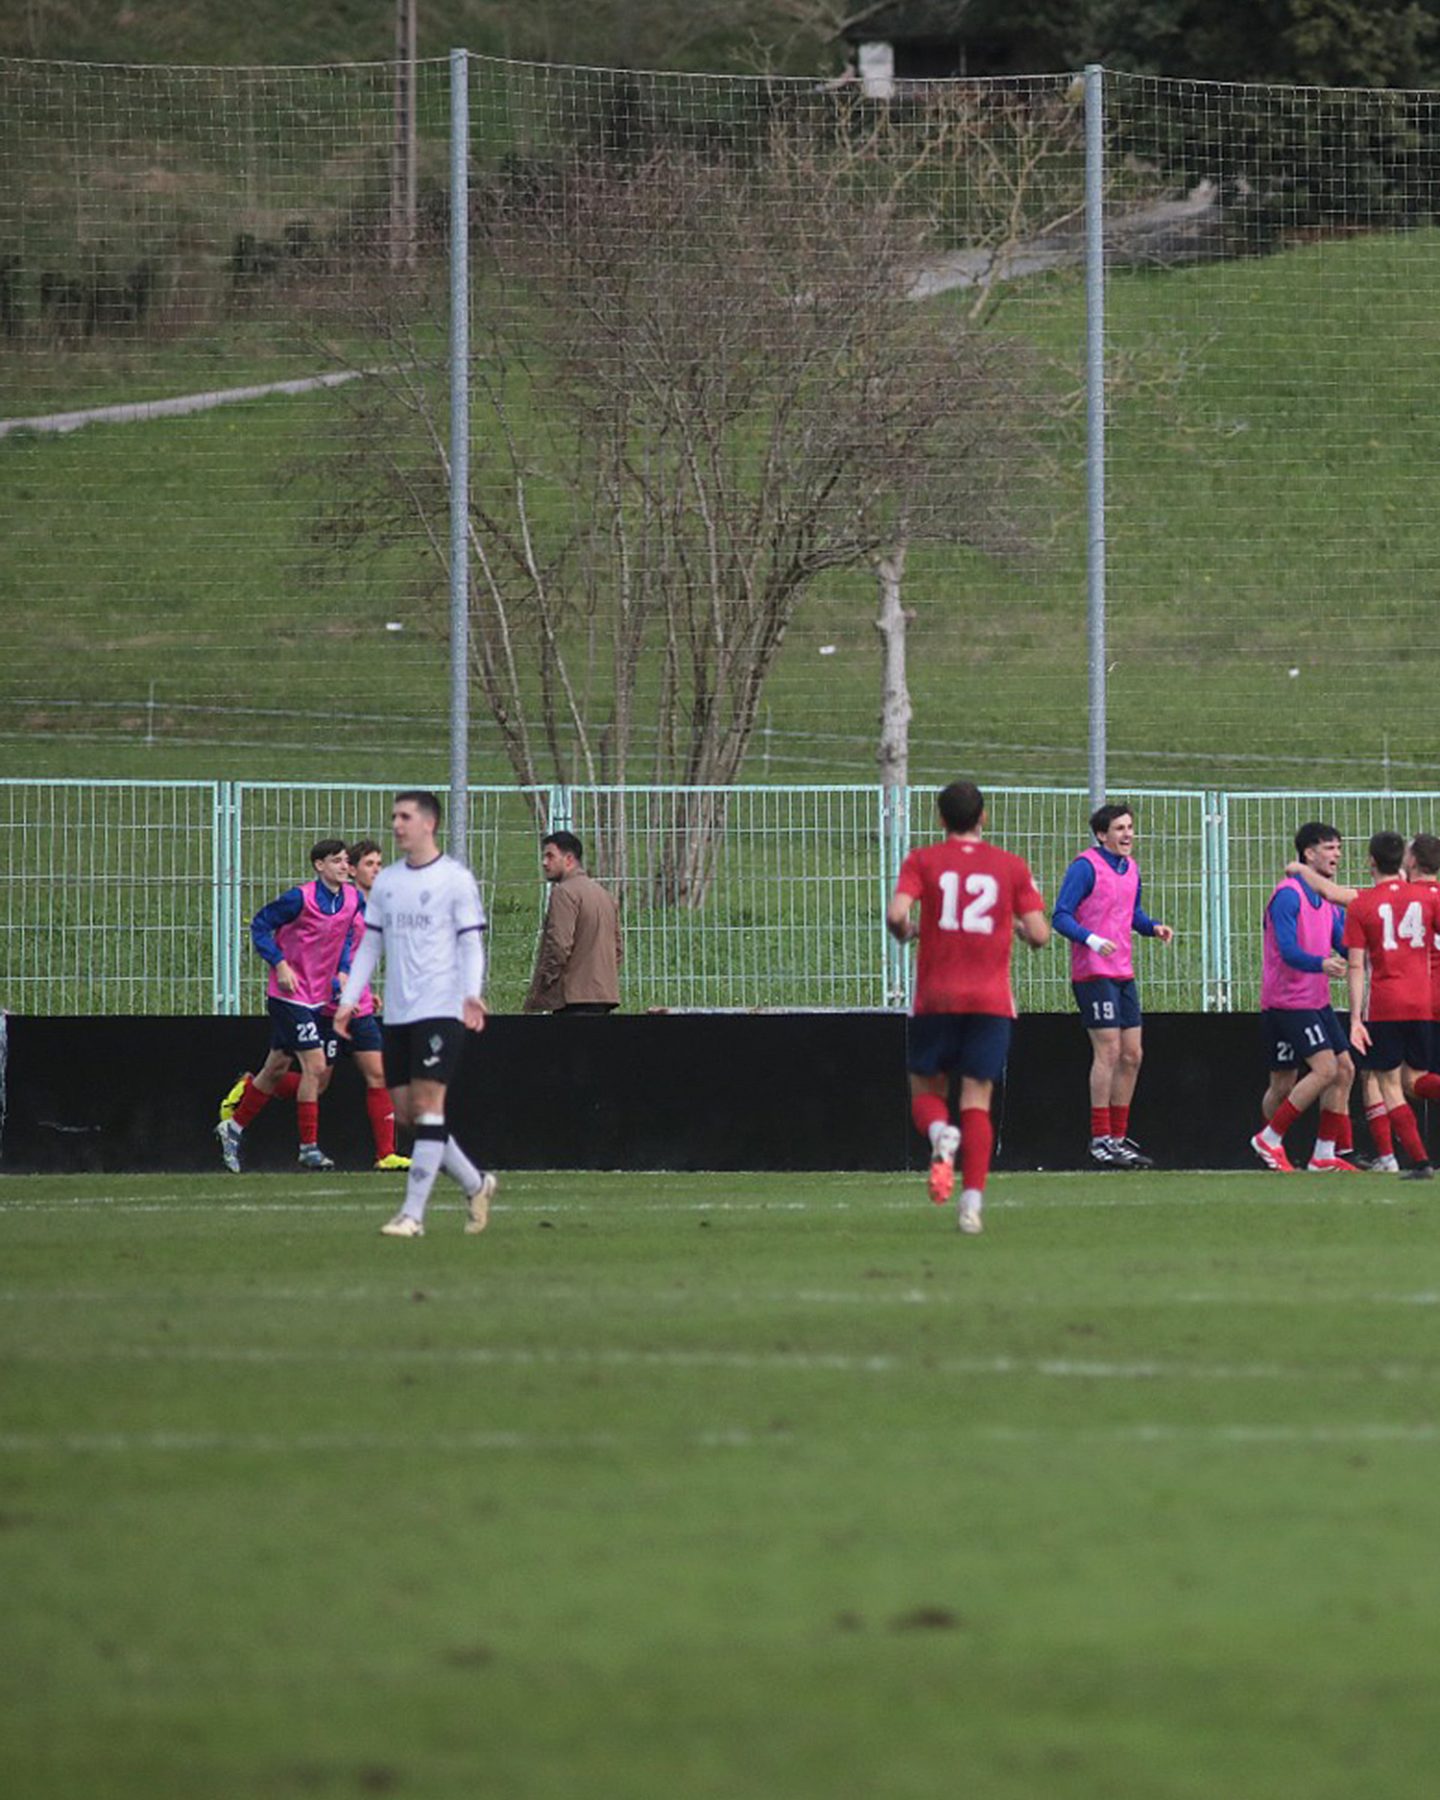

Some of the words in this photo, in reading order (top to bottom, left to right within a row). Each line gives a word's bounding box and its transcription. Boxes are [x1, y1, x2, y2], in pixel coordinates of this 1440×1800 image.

[938, 870, 998, 935] 12
[1378, 901, 1426, 951] 14
[1092, 1001, 1115, 1020] 19
[296, 1021, 319, 1042] 22
[1304, 1024, 1325, 1046] 11
